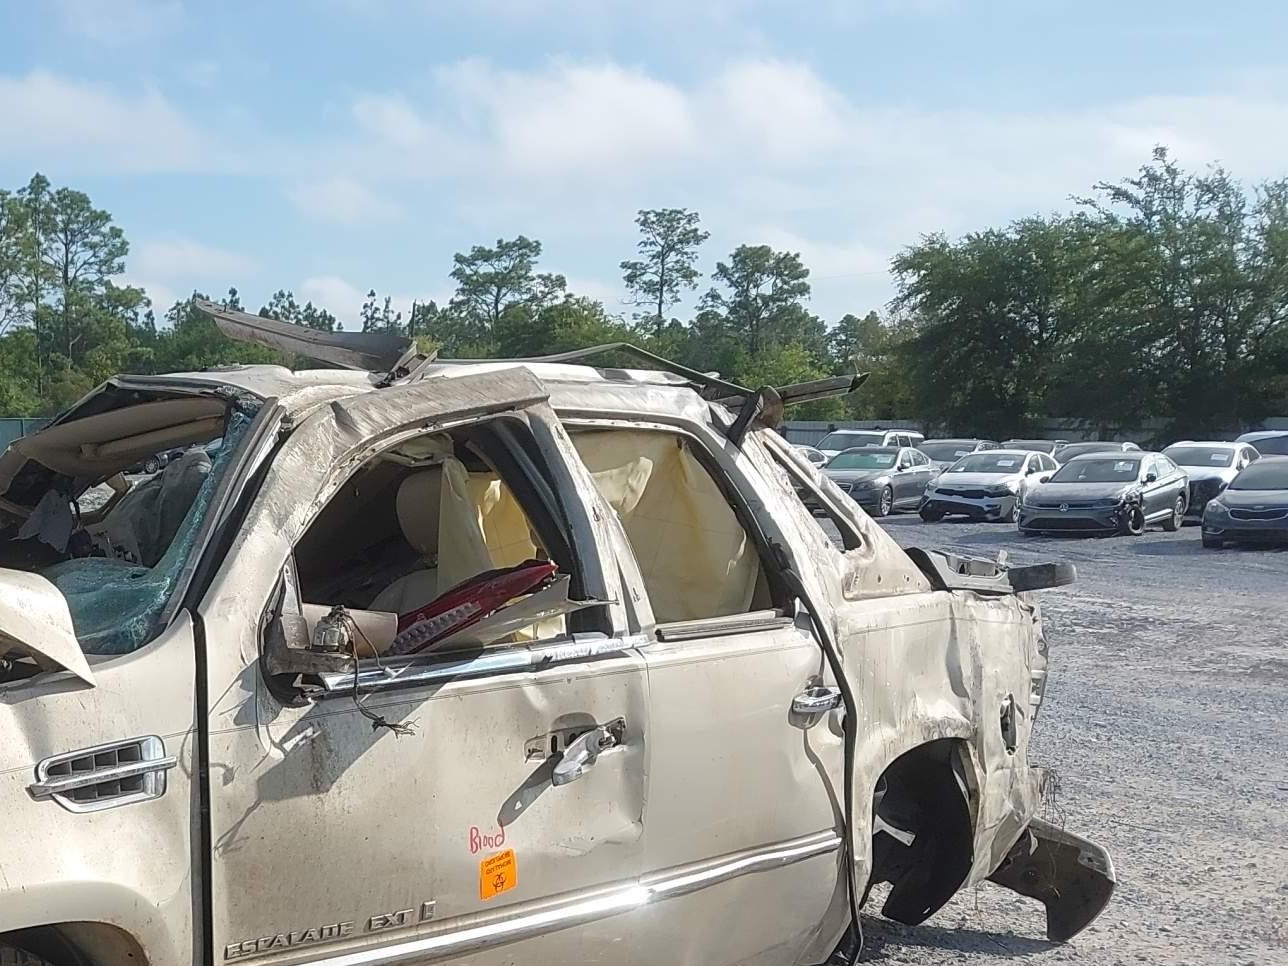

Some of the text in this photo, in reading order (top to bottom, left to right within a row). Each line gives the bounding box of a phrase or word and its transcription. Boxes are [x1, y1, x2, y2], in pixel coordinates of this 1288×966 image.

[470, 826, 505, 854] Blood
[224, 908, 414, 960] ESCALADE EXT
